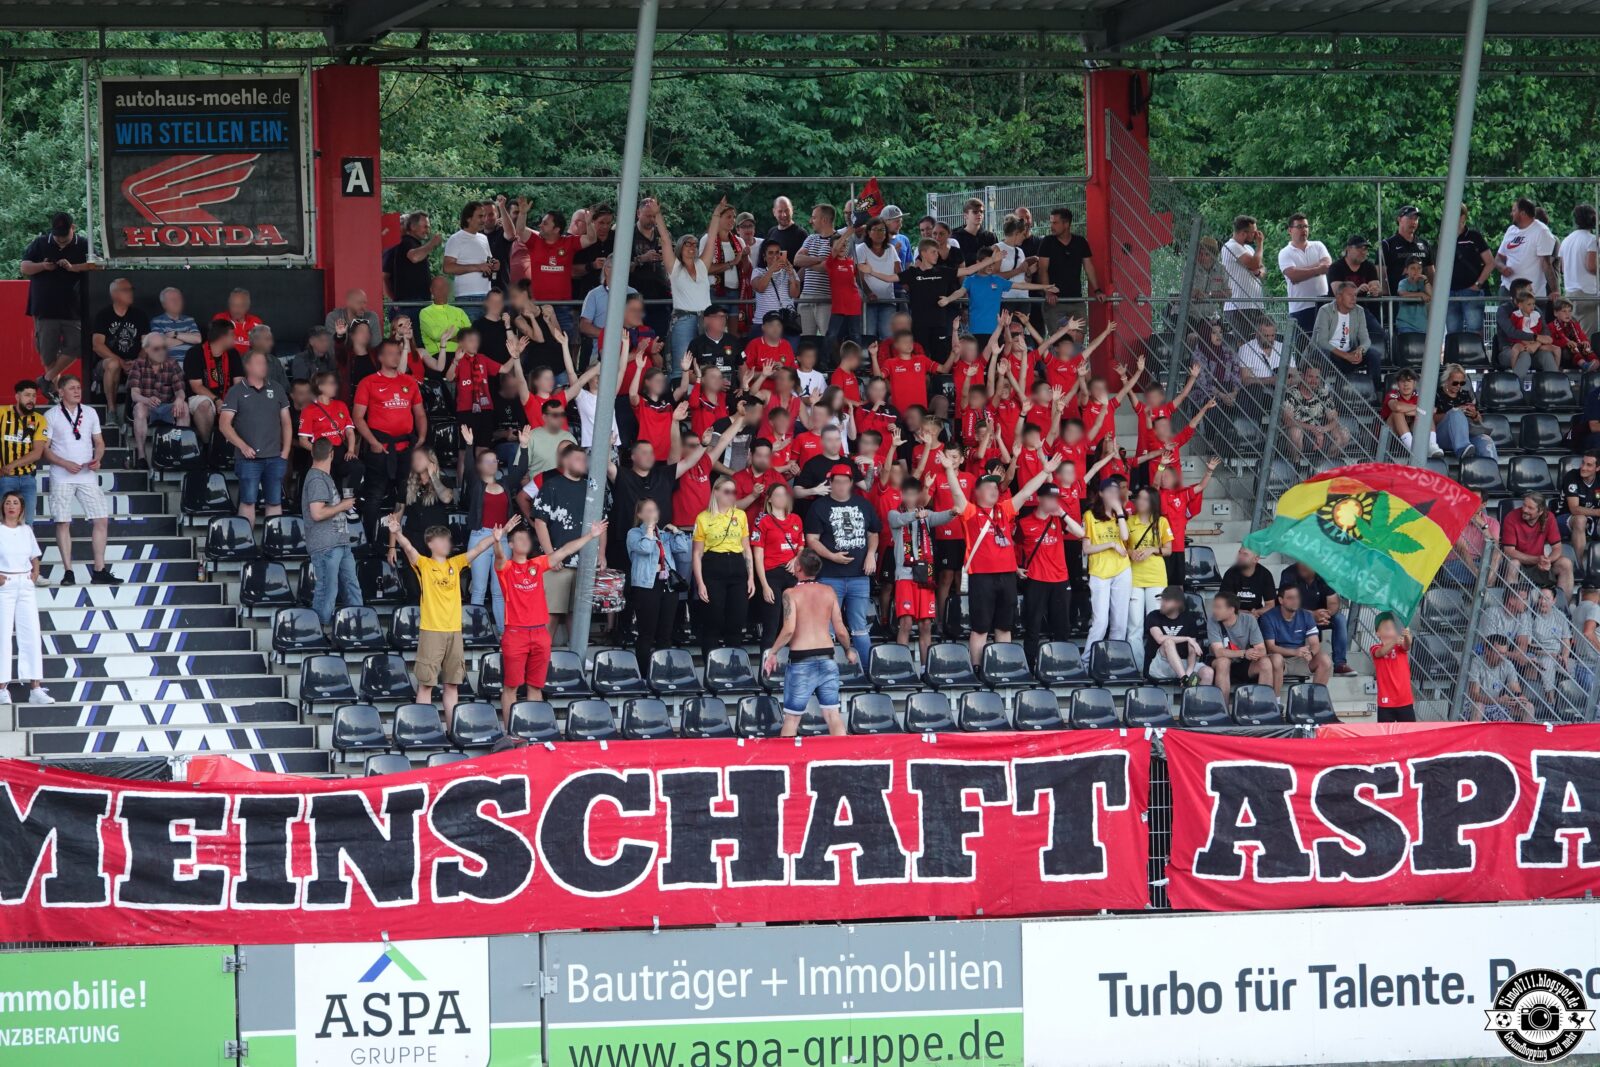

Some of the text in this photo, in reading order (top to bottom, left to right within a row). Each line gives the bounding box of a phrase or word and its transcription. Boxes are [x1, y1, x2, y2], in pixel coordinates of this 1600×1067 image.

[115, 88, 291, 108] autohaus-moehle.de
[115, 120, 289, 145] WIR STELLEN EIN:
[346, 161, 370, 193] A
[124, 223, 288, 247] HONDA
[0, 750, 1600, 911] MEINSCHAFT ASPA
[0, 980, 148, 1013] mmobilie!
[567, 950, 1004, 1010] Bauträger + Immobilien
[1098, 969, 1223, 1018] Turbo
[1234, 967, 1298, 1012] für
[1308, 963, 1475, 1009] Talente.
[315, 990, 471, 1039] ASPA
[350, 1045, 438, 1067] GRUPPE
[568, 1019, 1006, 1067] www.aspa-gruppe.de
